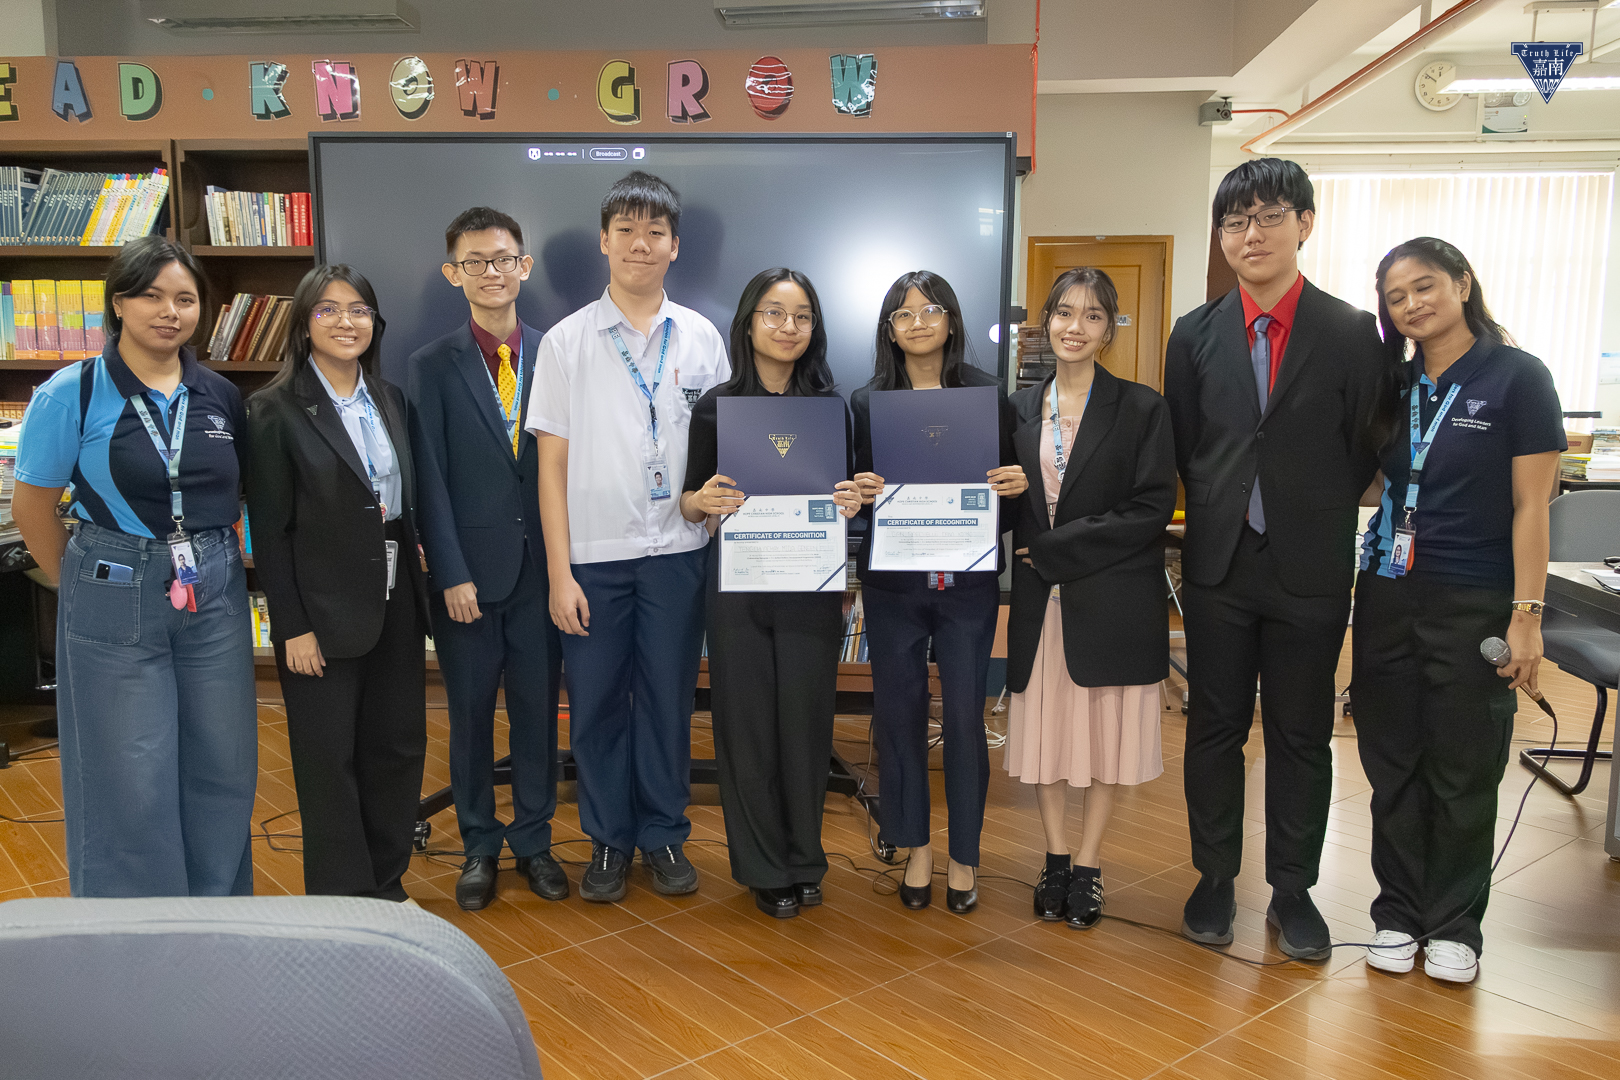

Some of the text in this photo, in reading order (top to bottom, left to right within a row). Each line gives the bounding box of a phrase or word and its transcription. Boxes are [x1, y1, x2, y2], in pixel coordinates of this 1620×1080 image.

[248, 56, 500, 122] KNOW
[597, 55, 878, 124] GROW
[783, 531, 825, 539] RECOGNITION
